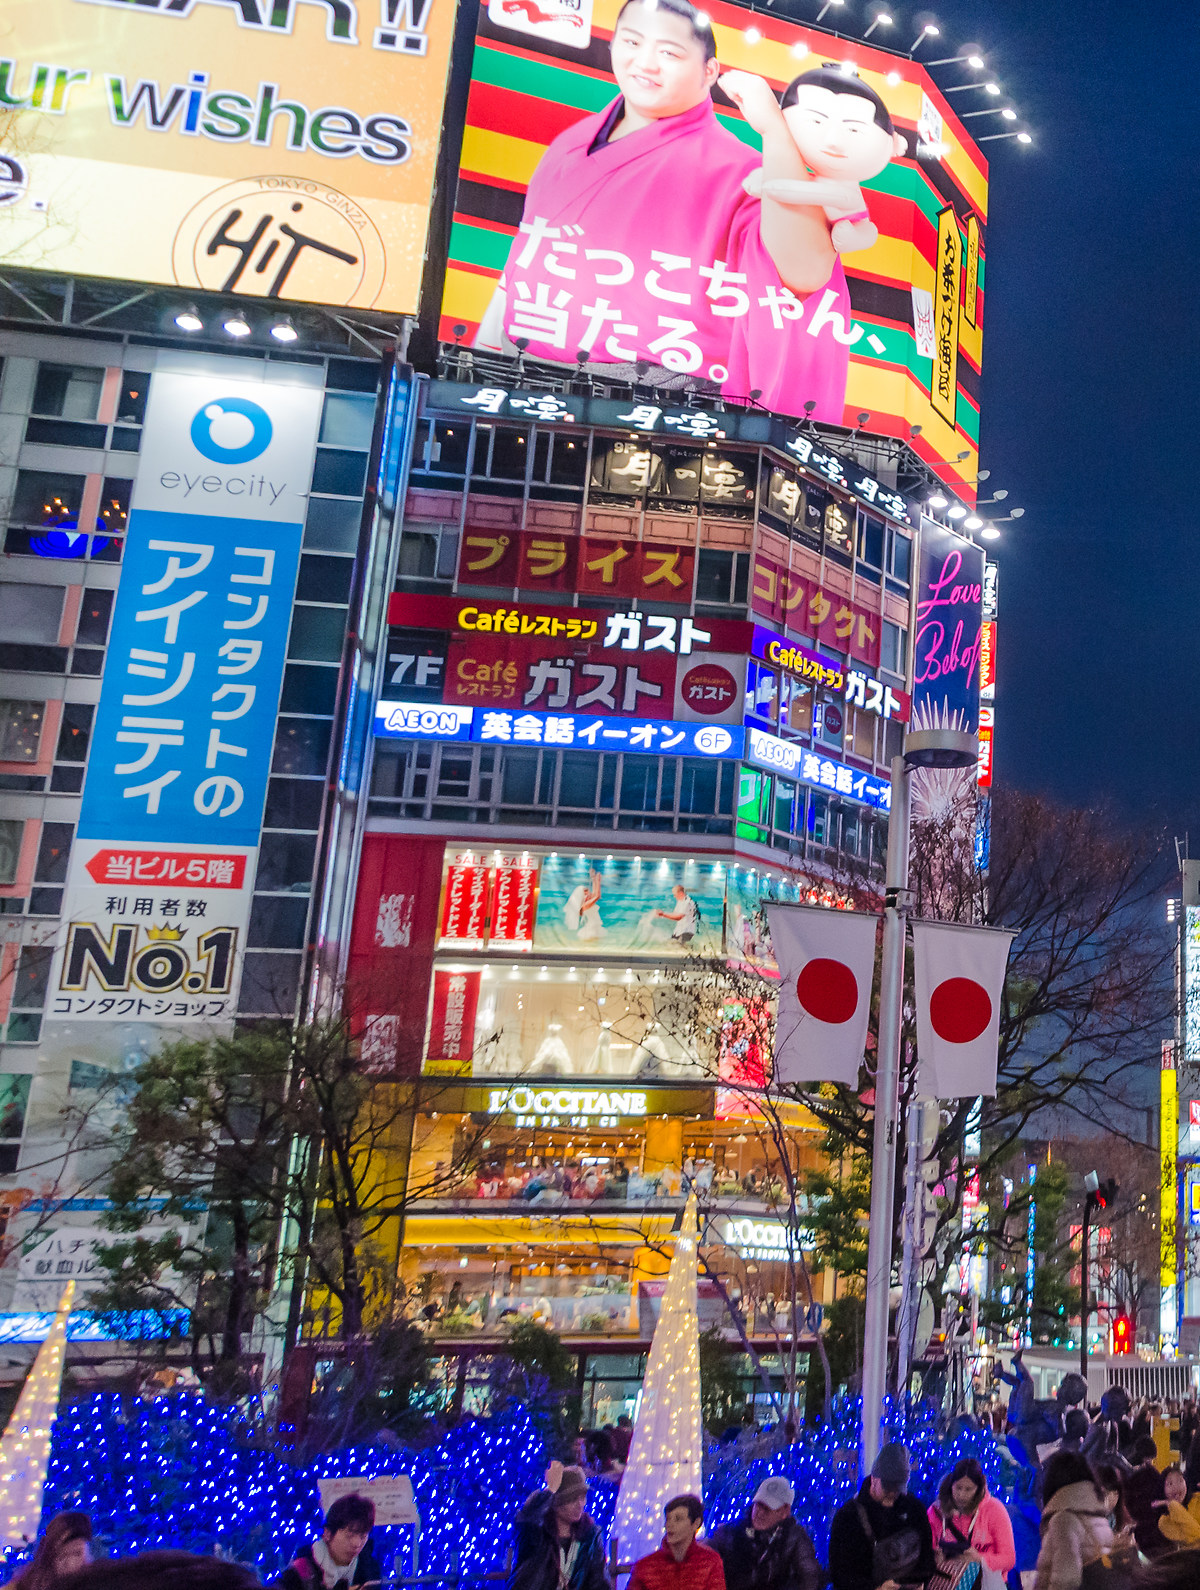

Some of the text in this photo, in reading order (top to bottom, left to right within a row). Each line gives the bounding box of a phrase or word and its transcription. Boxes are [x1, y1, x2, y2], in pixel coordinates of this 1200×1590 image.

[105, 70, 414, 166] wishes
[256, 176, 367, 232] TOKYO GINZA
[515, 215, 888, 356] だっこちゃん、
[507, 279, 729, 384] 当たる。
[160, 471, 287, 505] eyecity
[466, 535, 684, 588] プライス
[753, 563, 877, 648] コンタクト
[917, 549, 981, 620] Love
[458, 606, 711, 654] Caféレストラン ガスト
[389, 653, 444, 685] 7F
[457, 658, 518, 684] Café
[915, 620, 982, 690] Bebop
[114, 539, 214, 814] アイシティ
[193, 547, 275, 818] コンタクトの
[457, 683, 516, 699] レストラン
[524, 659, 662, 711] ガスト
[689, 685, 732, 701] ガスト
[845, 671, 901, 719] ガスト
[388, 708, 459, 732] AEON
[481, 712, 687, 749] 英会話イーオン
[700, 731, 727, 749] 6F
[755, 738, 796, 769] AEON
[105, 854, 236, 885] 当ビル5階
[454, 854, 487, 866] SALE
[502, 856, 534, 867] SALE
[105, 896, 208, 919] 利用者数
[445, 866, 466, 939] アウトレットドレス
[494, 868, 512, 940] アウトレットドレス
[59, 921, 239, 995] No.1
[54, 998, 230, 1017] コンタクトショップ
[488, 1086, 648, 1116] L'OCCITANE
[515, 1115, 537, 1128] EN
